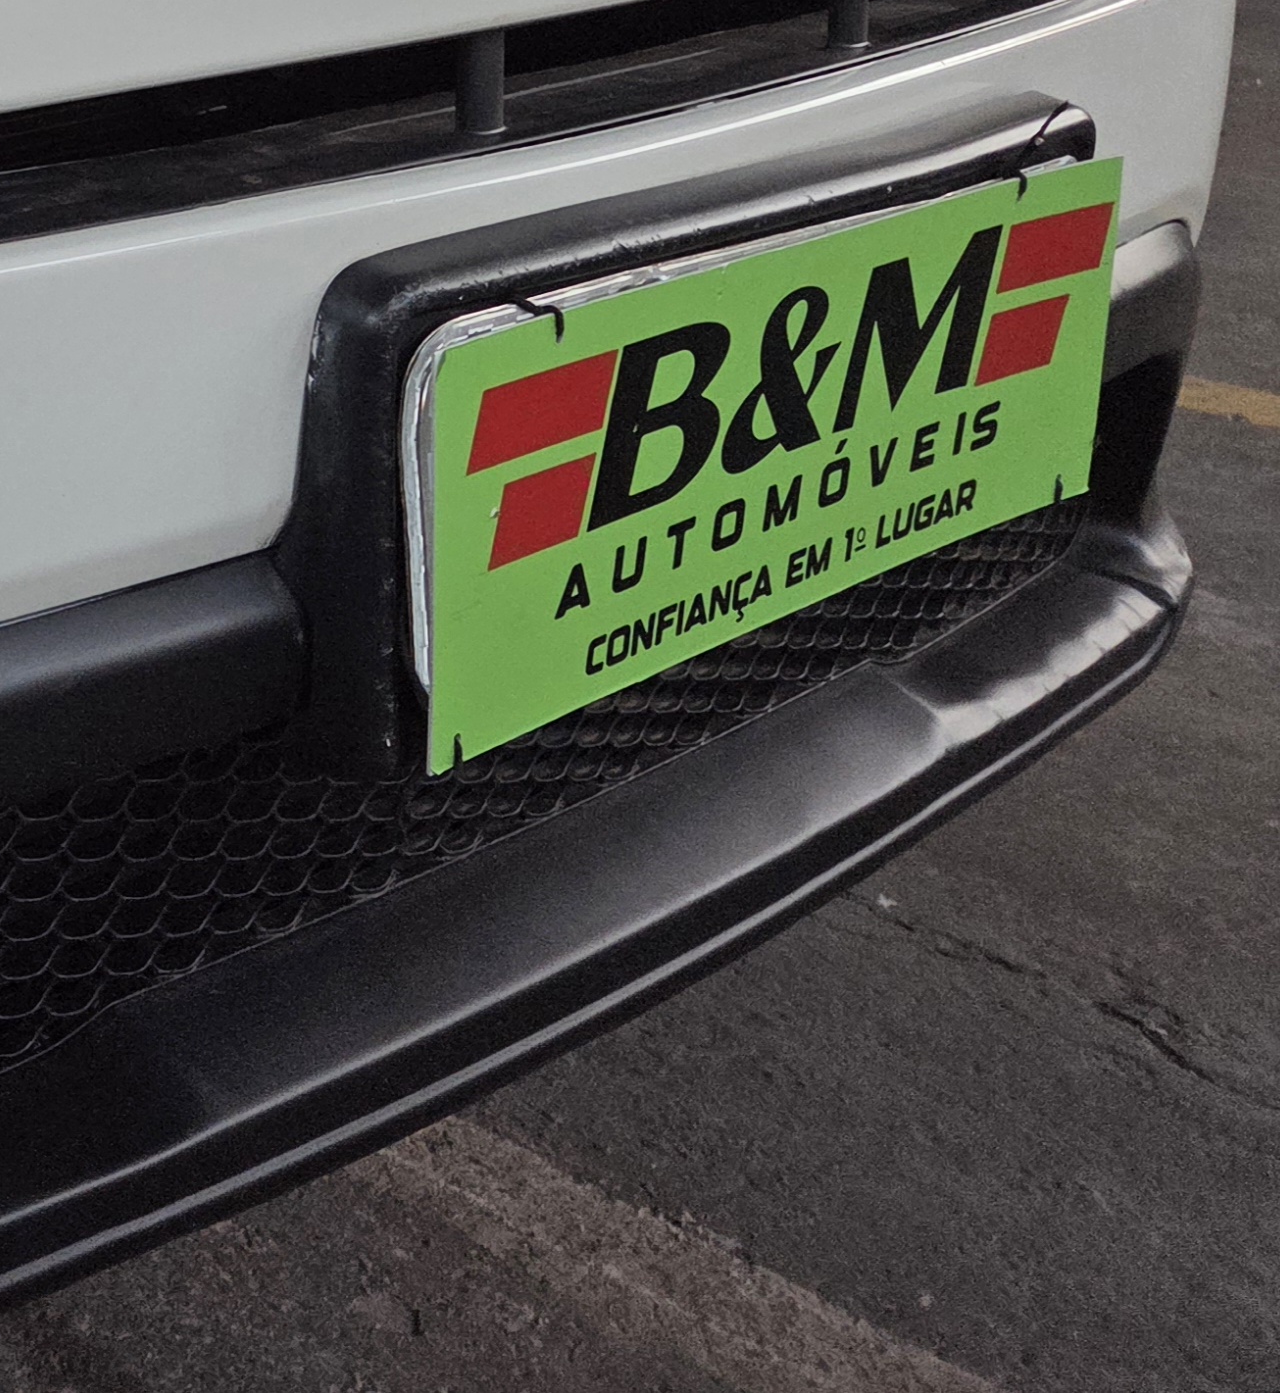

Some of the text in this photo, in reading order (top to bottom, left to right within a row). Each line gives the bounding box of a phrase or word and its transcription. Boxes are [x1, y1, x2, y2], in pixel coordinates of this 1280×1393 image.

[585, 224, 1003, 533] B&M
[554, 400, 1002, 621] AUTOMÓVEIS
[585, 564, 773, 676] CONFIANÇA
[785, 537, 833, 589] EM
[875, 478, 978, 550] LUGAR
